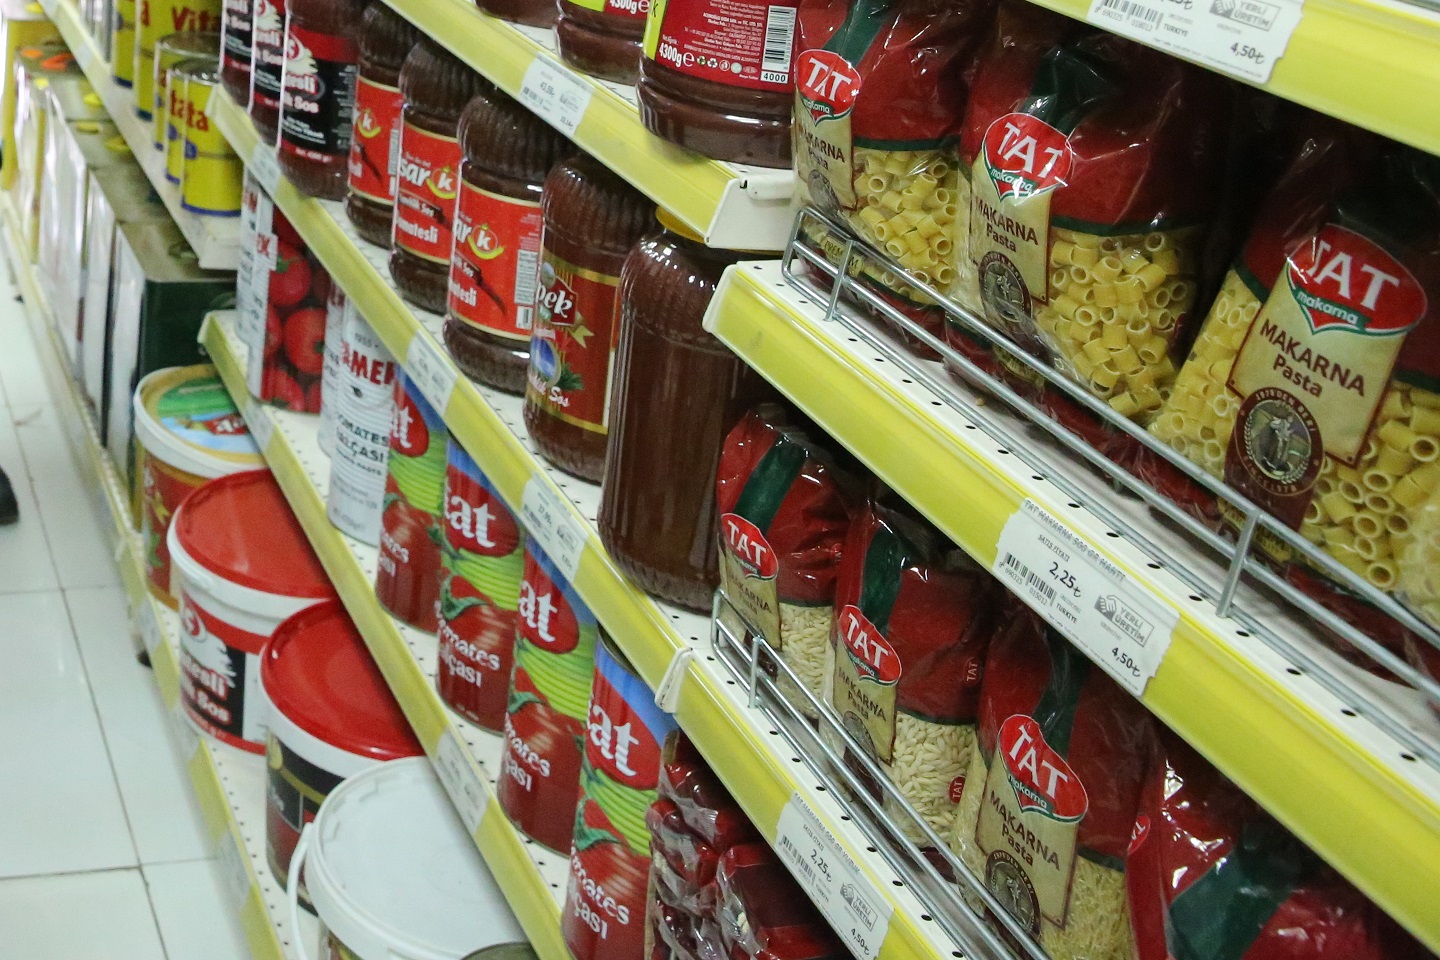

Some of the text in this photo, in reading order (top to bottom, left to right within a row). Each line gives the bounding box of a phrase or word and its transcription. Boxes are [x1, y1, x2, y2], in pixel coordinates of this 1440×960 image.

[658, 42, 683, 68] 4300g
[763, 71, 787, 84] 4000
[808, 58, 852, 102] TAT
[996, 121, 1064, 178] TAT
[974, 197, 1039, 246] MAKARNA
[986, 225, 1018, 253] Pasta
[1306, 239, 1400, 312] TAT
[537, 285, 573, 319] pek
[1296, 289, 1359, 326] makarna
[1260, 318, 1366, 397] MAKARNA
[1272, 354, 1324, 399] Pasta
[727, 520, 767, 568] TAT
[520, 580, 558, 643] at
[846, 612, 889, 670] TAT
[1007, 723, 1070, 799] TAT
[952, 779, 963, 801] TAT
[988, 795, 1061, 872] MAKARNA
[1001, 824, 1035, 867] Pasta
